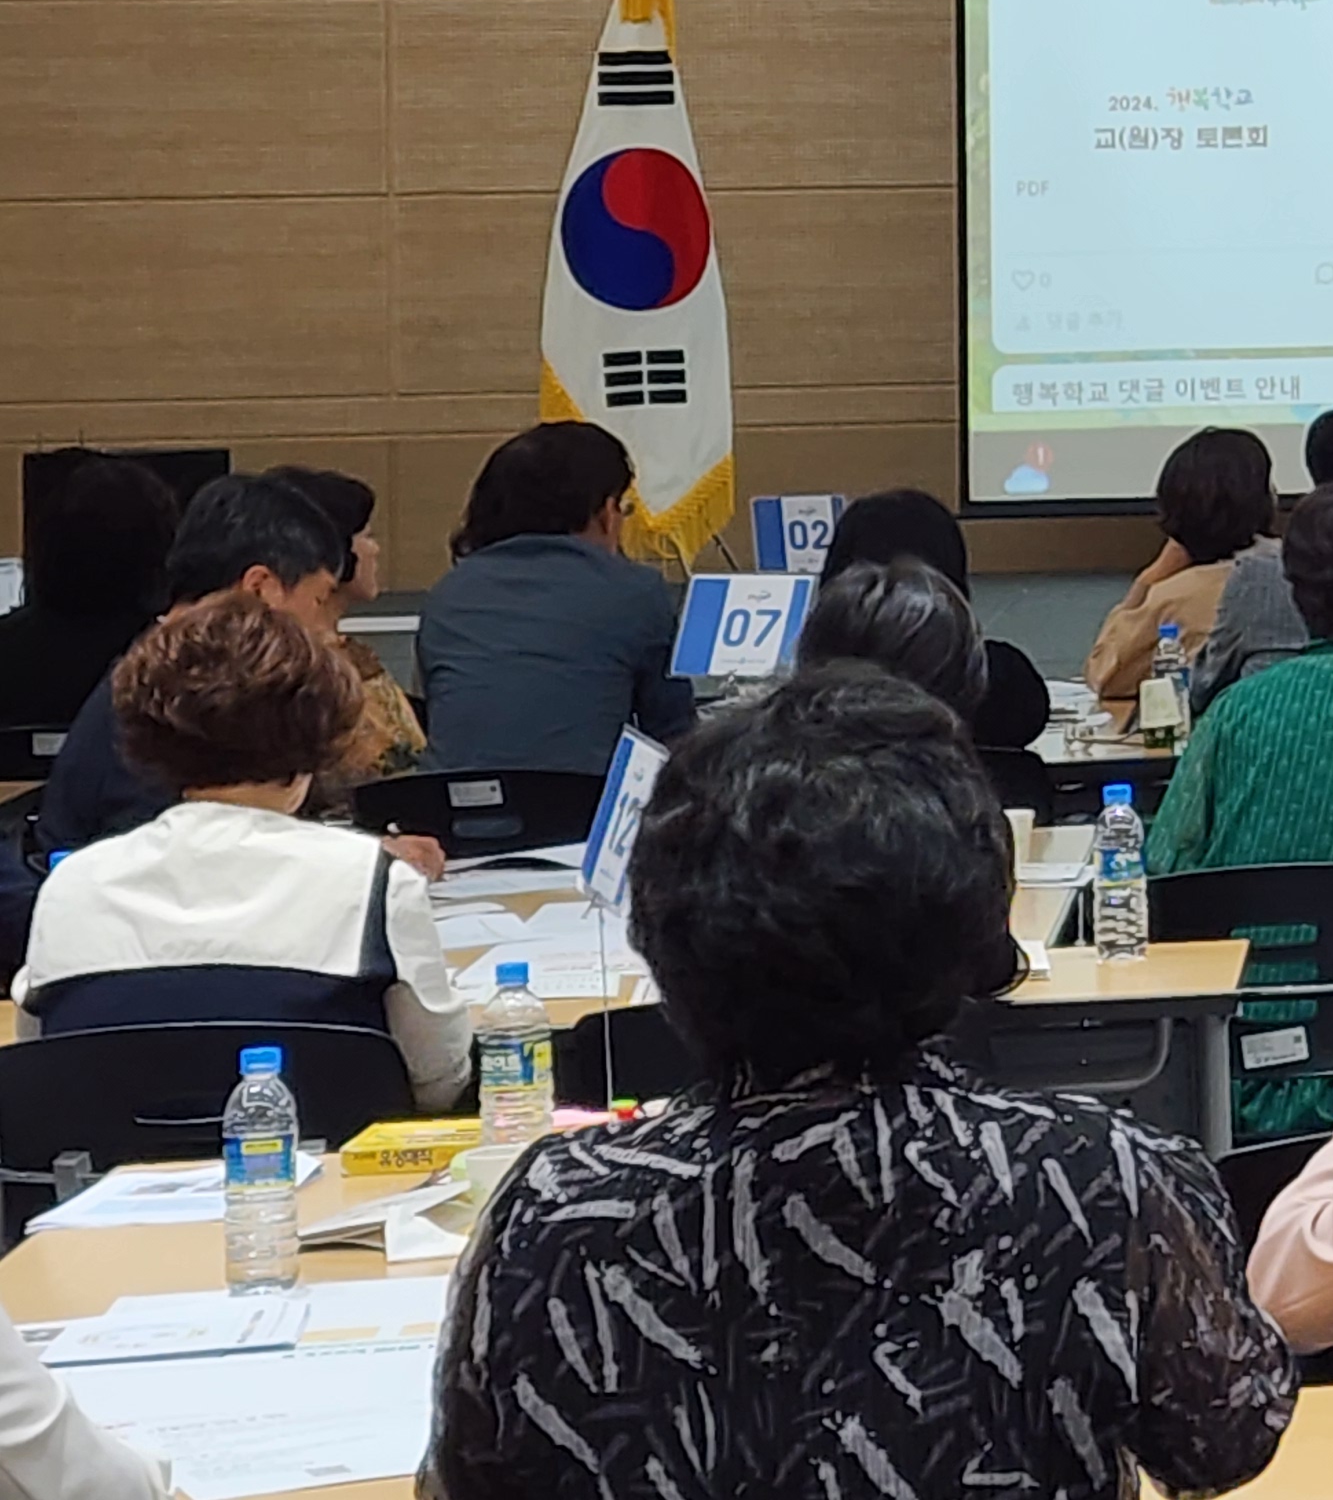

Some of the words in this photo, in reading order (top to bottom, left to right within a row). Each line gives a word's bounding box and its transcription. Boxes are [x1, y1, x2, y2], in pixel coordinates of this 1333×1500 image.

[1108, 95, 1159, 113] 2024.
[1166, 87, 1254, 112] 행복학교
[1094, 126, 1183, 150] 교(원)장
[1197, 125, 1269, 149] 토론회
[1016, 180, 1050, 197] PDF
[1012, 380, 1109, 407] 행복학교
[1118, 378, 1165, 403] 댓글
[1176, 377, 1246, 402] 이벤트
[1255, 375, 1301, 401] 안내
[788, 519, 829, 551] 02
[722, 608, 783, 648] 07
